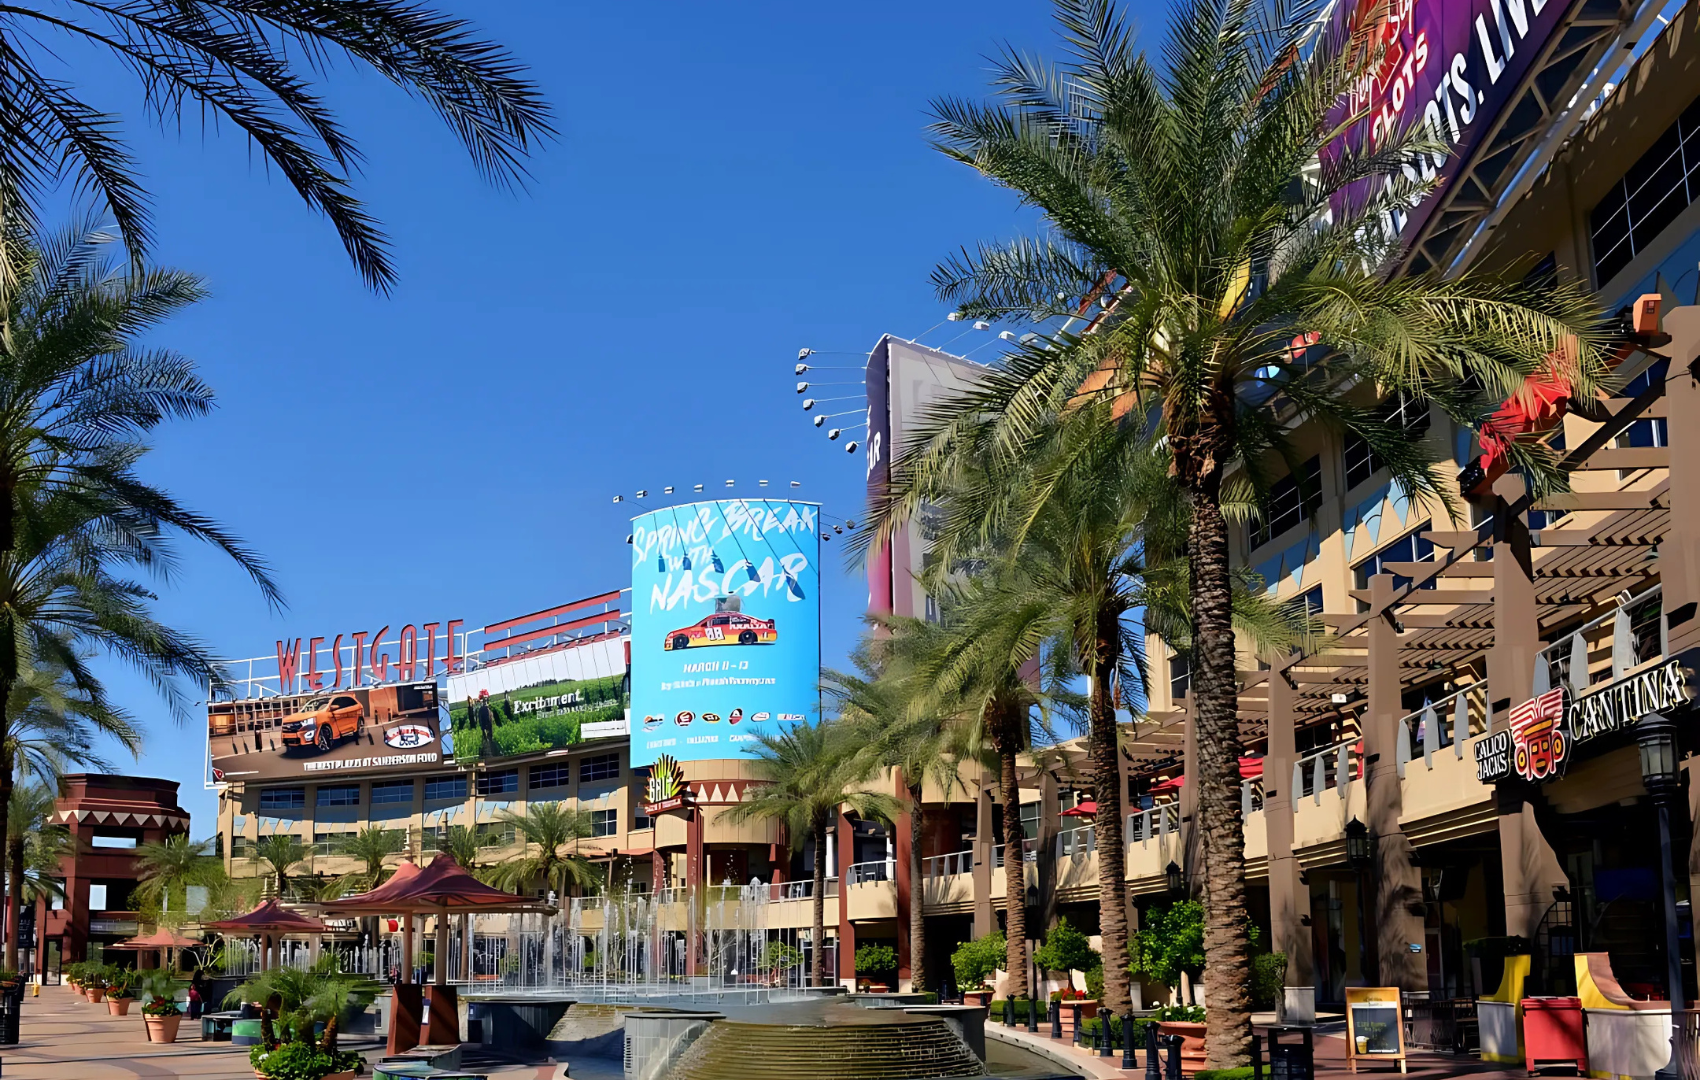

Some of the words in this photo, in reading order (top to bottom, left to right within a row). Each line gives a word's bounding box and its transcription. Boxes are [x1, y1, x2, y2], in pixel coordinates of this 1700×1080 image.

[1474, 0, 1548, 86] LIV
[632, 507, 719, 572] SPRING
[715, 501, 818, 544] BREAK
[650, 552, 809, 616] NASCAR
[276, 618, 464, 696] WESTGATE
[1568, 660, 1690, 742] CANTINA
[1475, 730, 1508, 761] CALICO
[1477, 751, 1508, 780] JACKS
